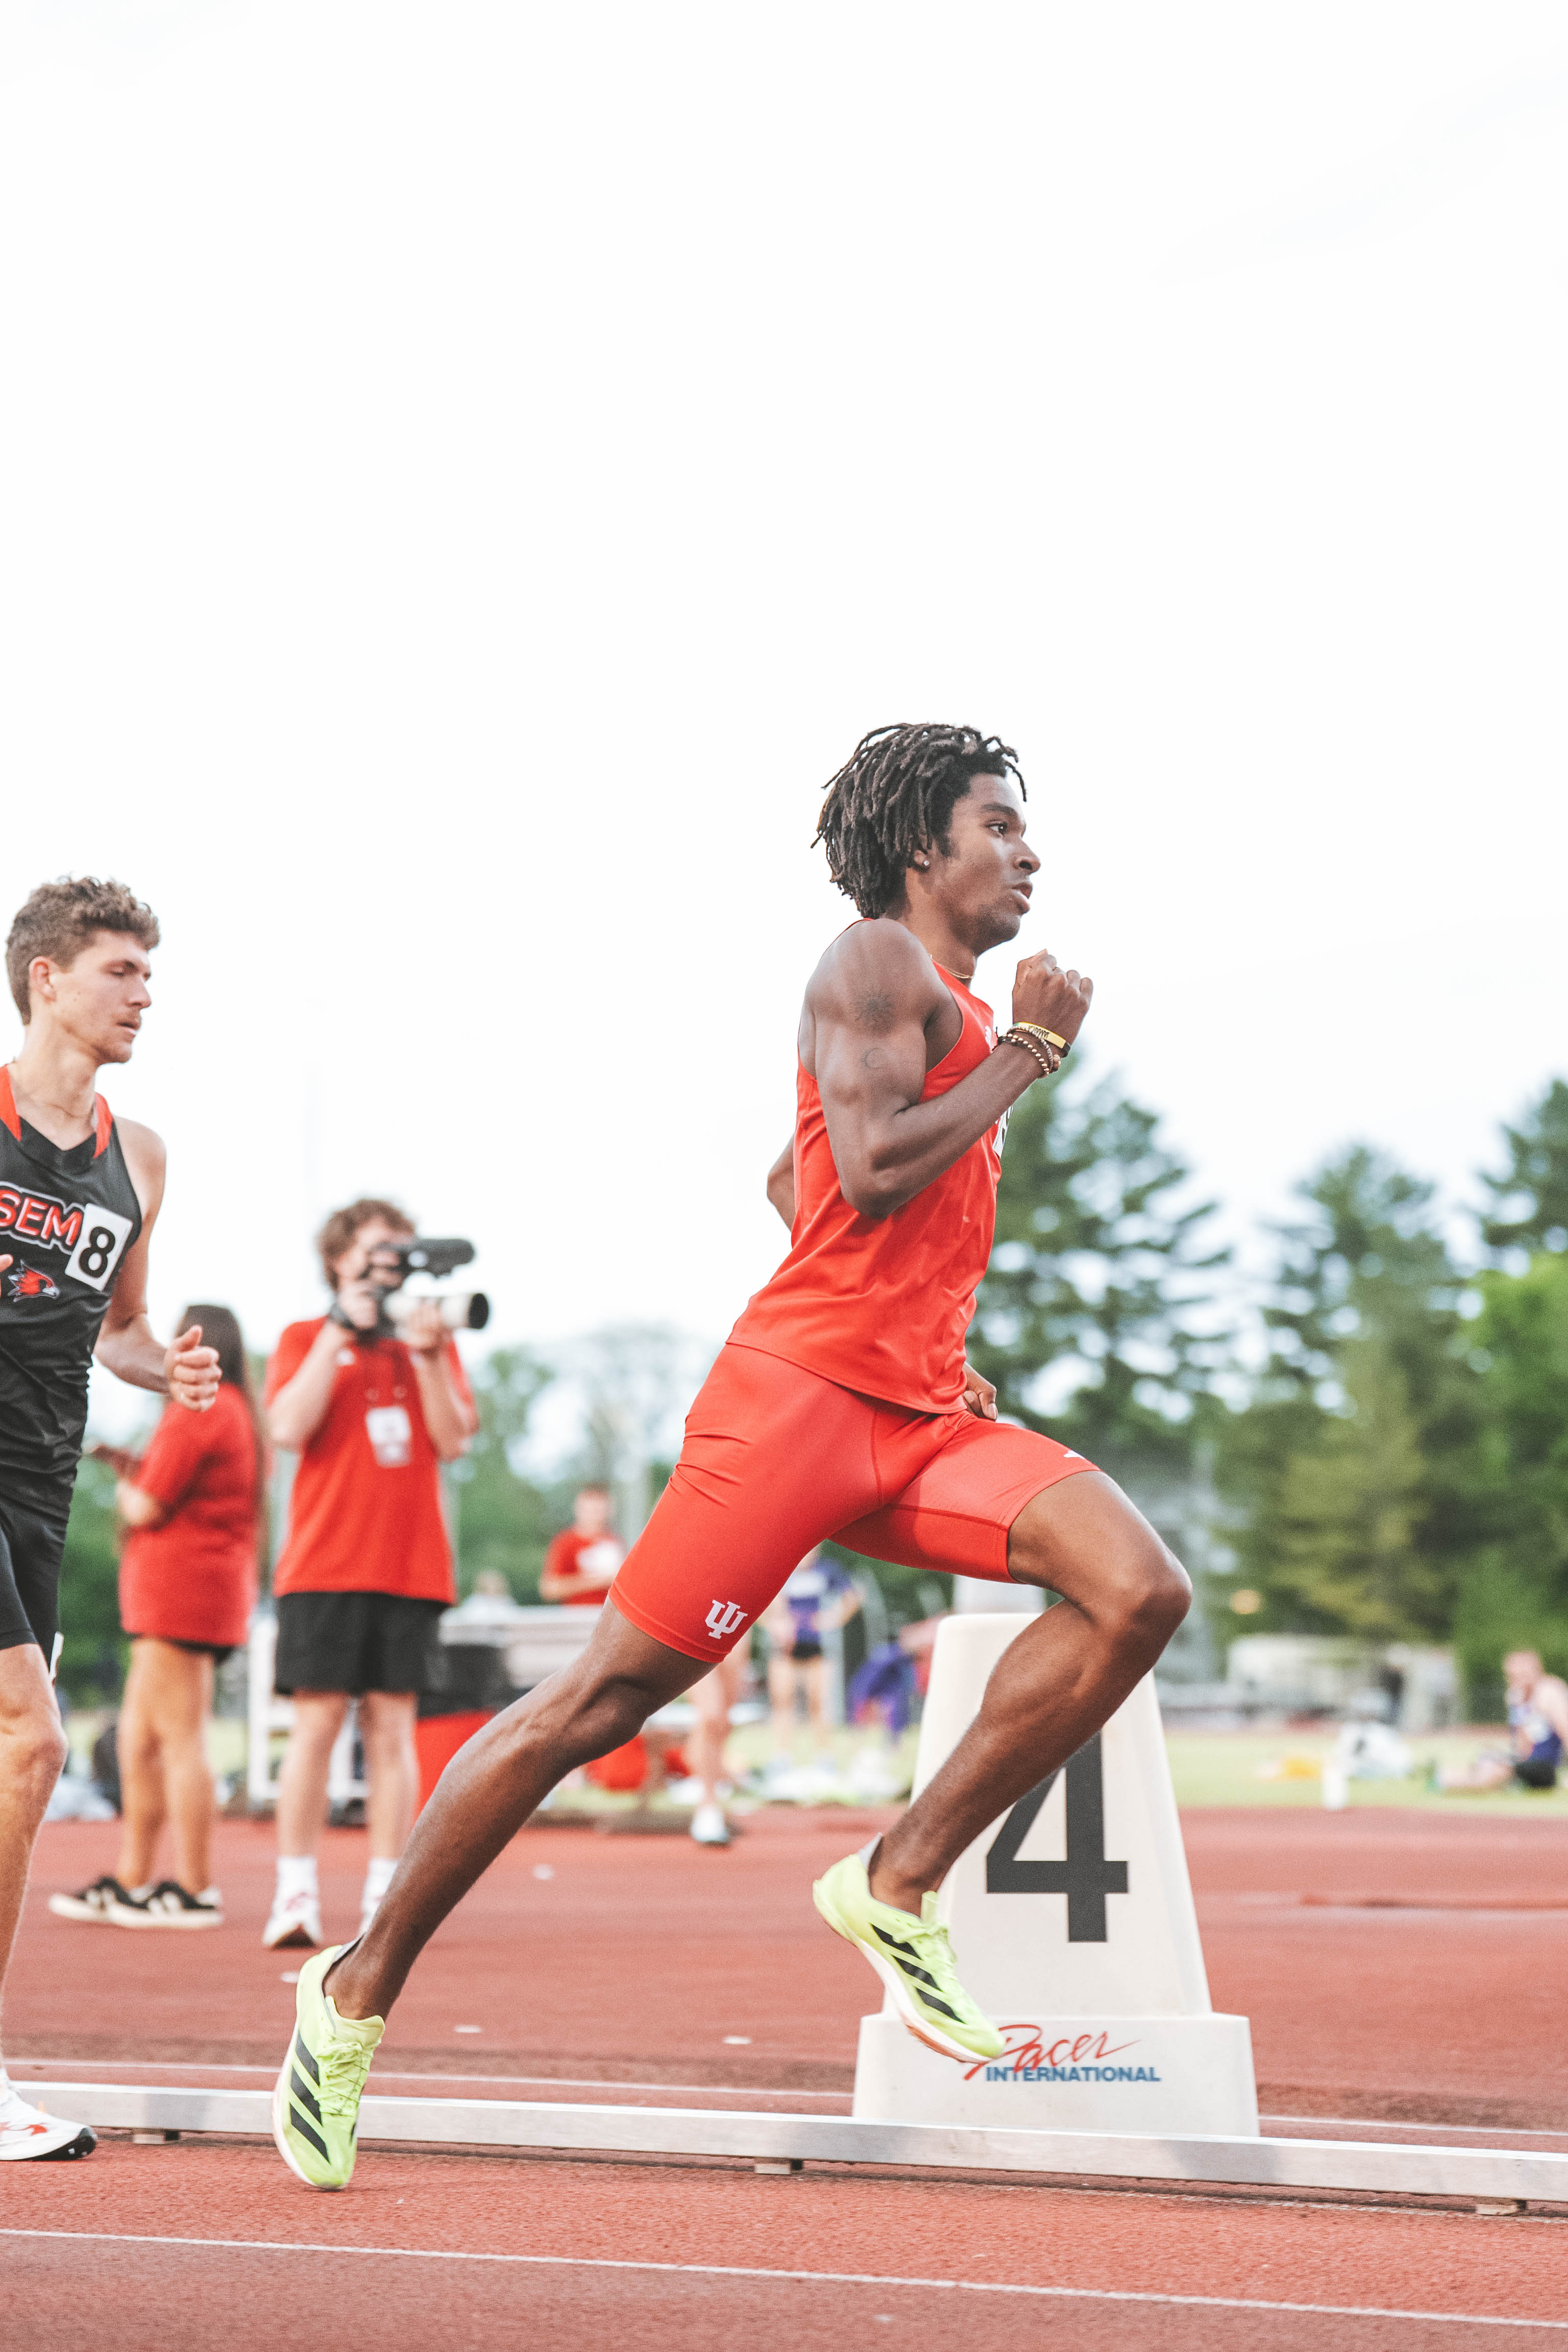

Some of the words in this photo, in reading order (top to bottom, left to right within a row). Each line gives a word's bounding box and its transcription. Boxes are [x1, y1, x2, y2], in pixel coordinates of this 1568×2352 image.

[79, 1226, 115, 1279] 8
[987, 1729, 1129, 1942] 4
[964, 2024, 1142, 2080] Pacer
[986, 2067, 1161, 2082] INTERNATIONAL
